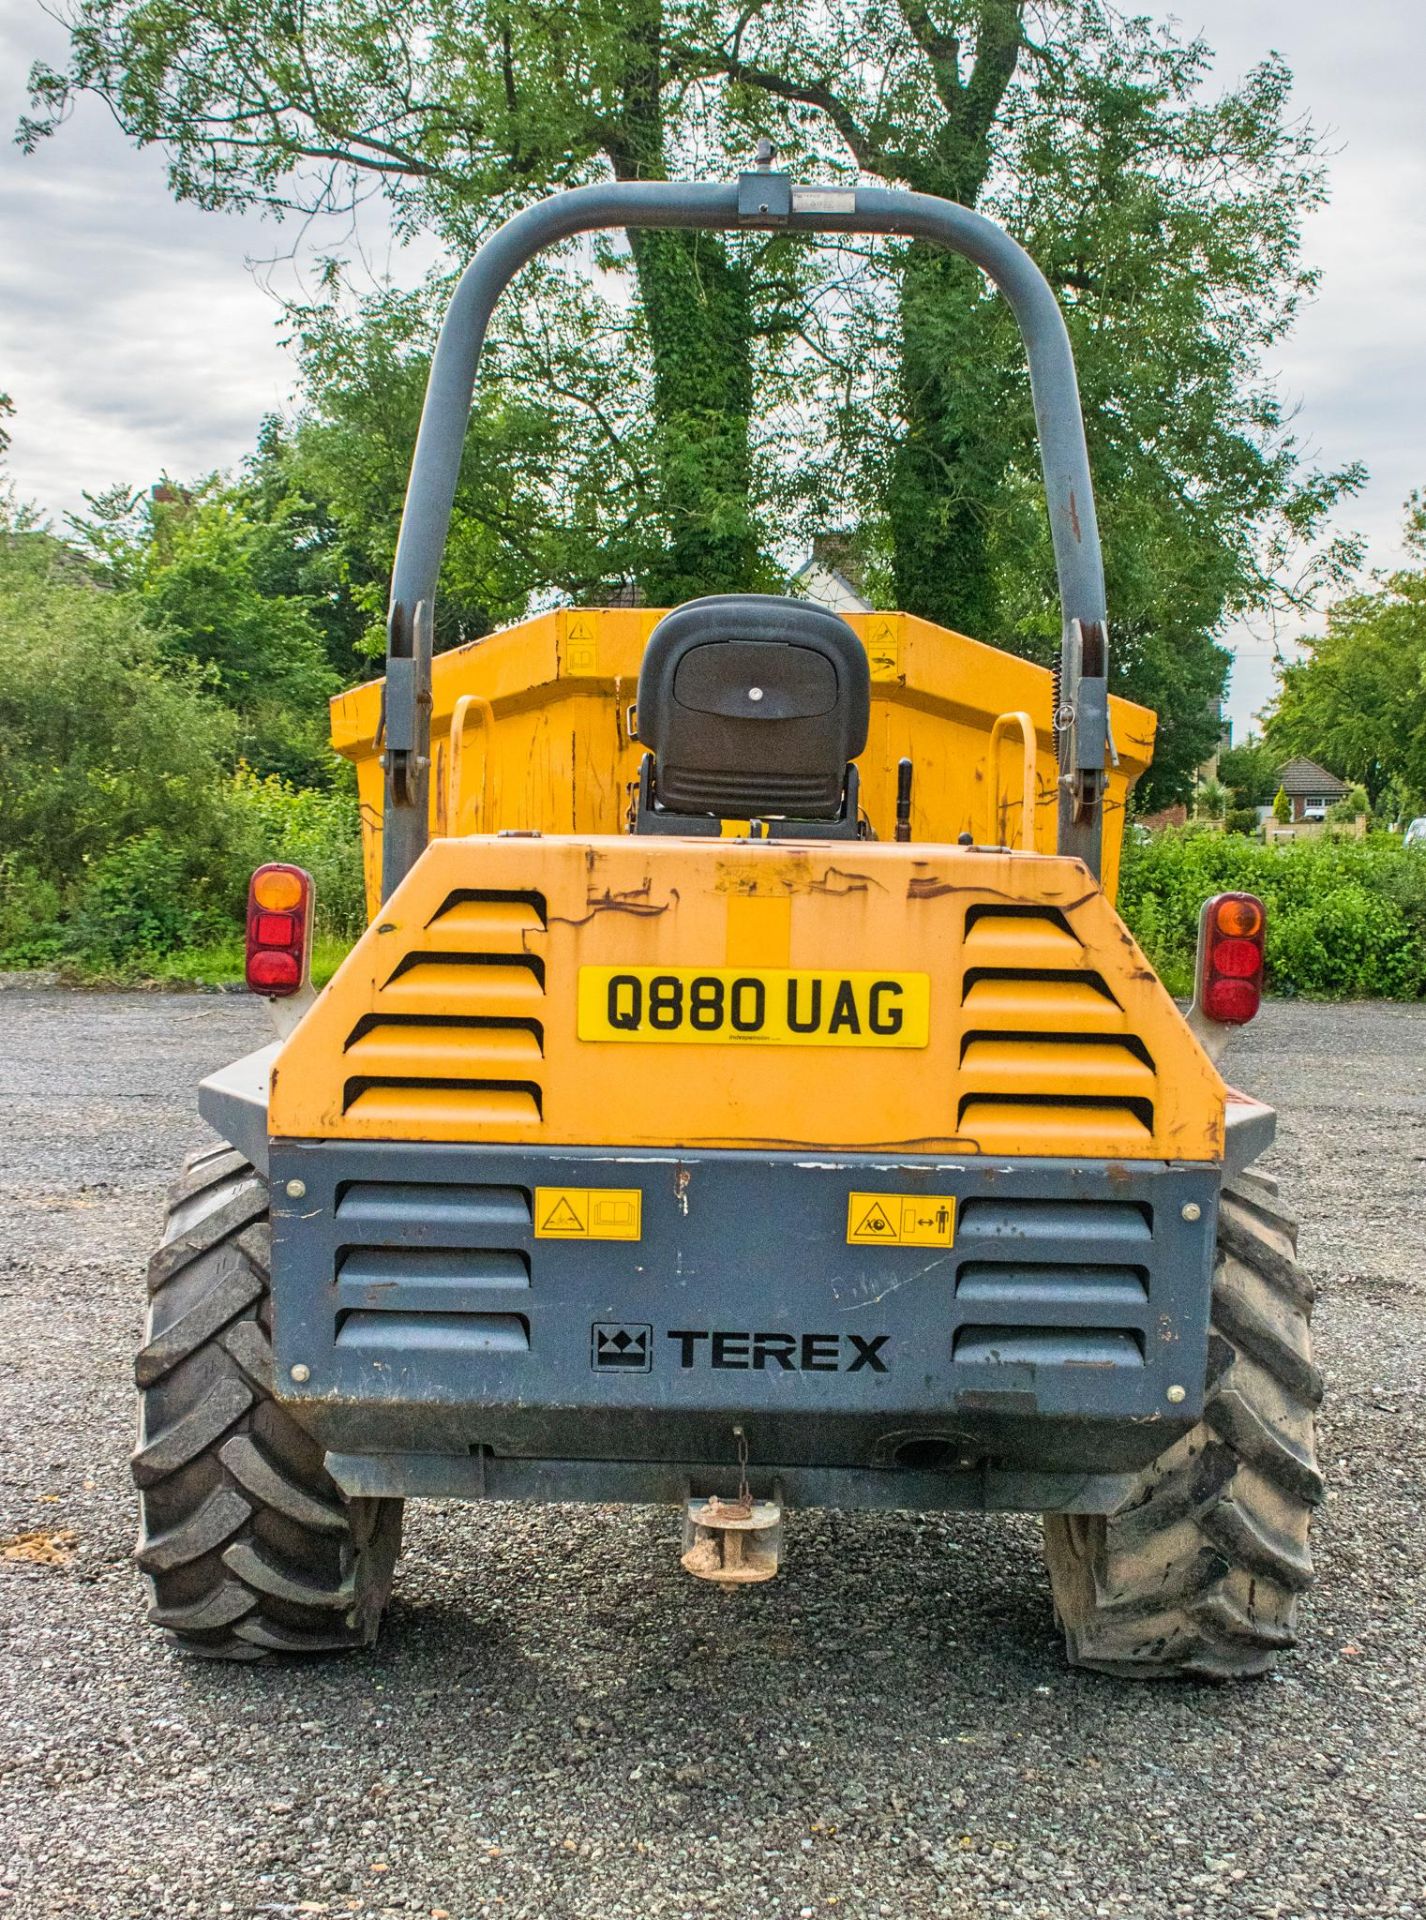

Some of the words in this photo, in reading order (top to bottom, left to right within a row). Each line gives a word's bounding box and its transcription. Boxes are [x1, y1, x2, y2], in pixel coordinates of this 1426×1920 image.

[607, 974, 766, 1032] Q880
[787, 978, 904, 1035] UAG
[667, 1330, 891, 1373] TEREX
